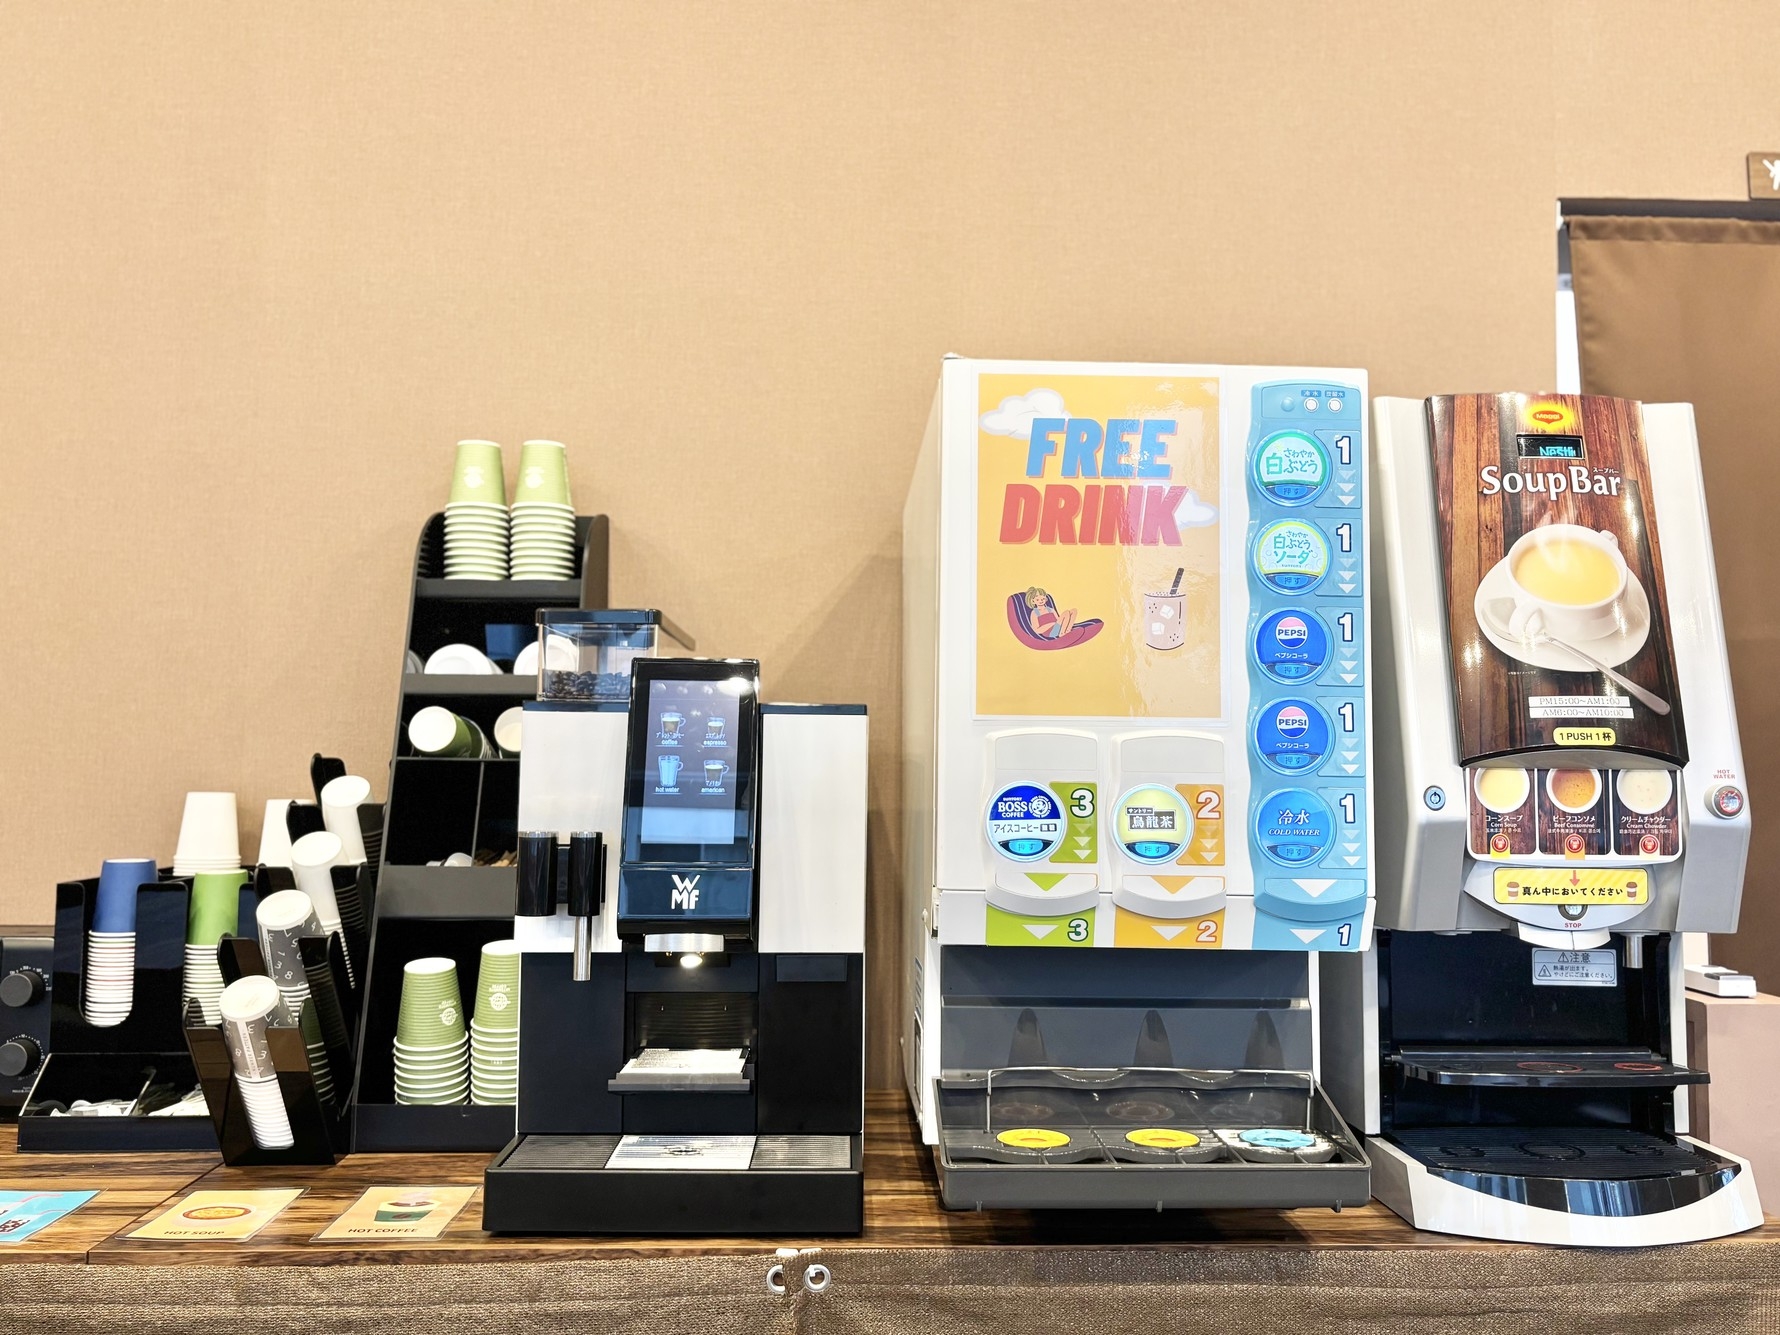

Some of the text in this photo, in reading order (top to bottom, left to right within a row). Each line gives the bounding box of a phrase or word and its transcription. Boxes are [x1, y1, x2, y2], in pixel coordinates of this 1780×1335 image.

[1026, 418, 1178, 479] FREE
[1283, 448, 1316, 458] さわやか
[1335, 435, 1352, 465] 1
[999, 483, 1187, 546] DRINK
[1335, 522, 1352, 552] 1
[1273, 549, 1314, 565] ソーダ
[1277, 628, 1307, 638] PEPSI
[1337, 612, 1354, 642] 1
[1278, 718, 1308, 727] PEPSI
[1338, 702, 1355, 732] 1
[1566, 732, 1593, 741] PUSH
[997, 801, 1028, 813] BOSS
[1069, 787, 1095, 819] 3
[1195, 790, 1221, 820] 2
[1339, 793, 1356, 824] 1
[1277, 809, 1310, 826] 冷水
[1268, 828, 1321, 837] COLD WATER
[1522, 886, 1624, 897] 真ん中においてください
[1067, 917, 1089, 942] 3
[1195, 919, 1219, 943] 2
[1337, 923, 1352, 947] 1
[1569, 952, 1591, 963] 注意
